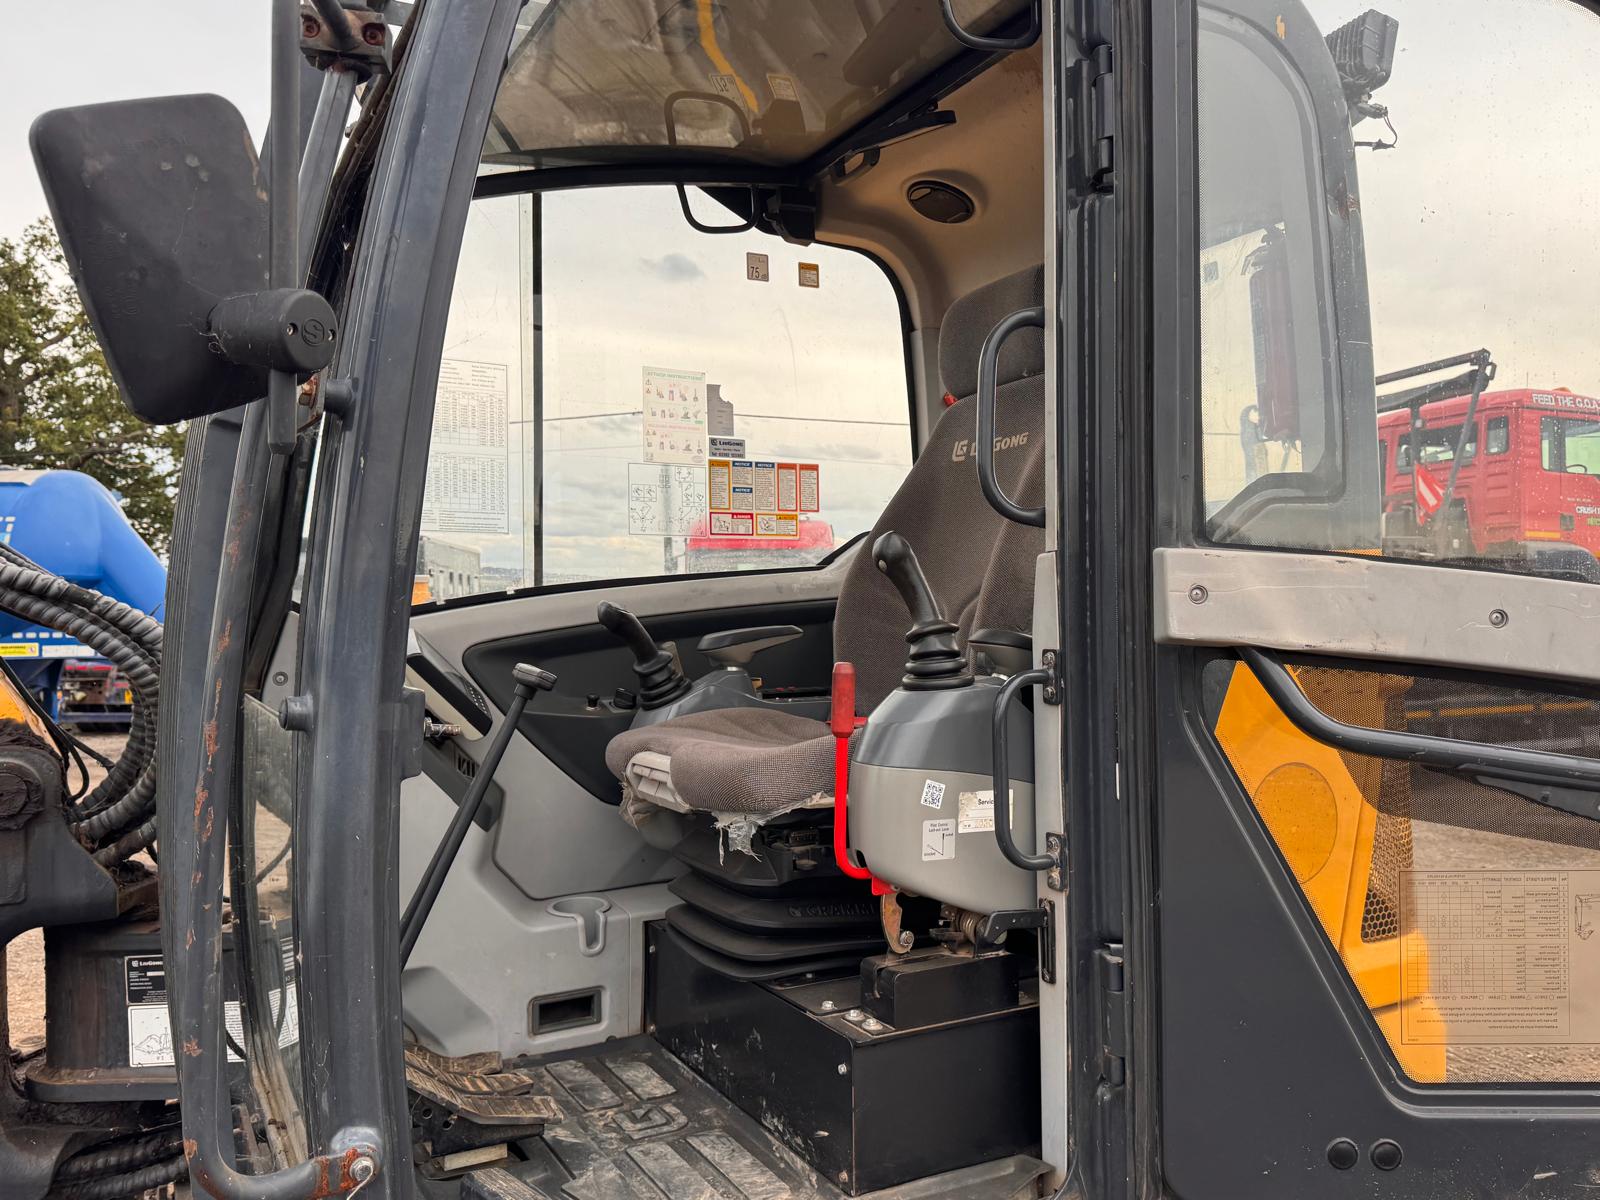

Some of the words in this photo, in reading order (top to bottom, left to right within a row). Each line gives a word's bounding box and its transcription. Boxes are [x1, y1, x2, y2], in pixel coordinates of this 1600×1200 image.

[750, 266, 760, 279] 75
[1532, 393, 1555, 406] FEED
[1556, 395, 1575, 408] THE
[978, 798, 994, 806] Servic
